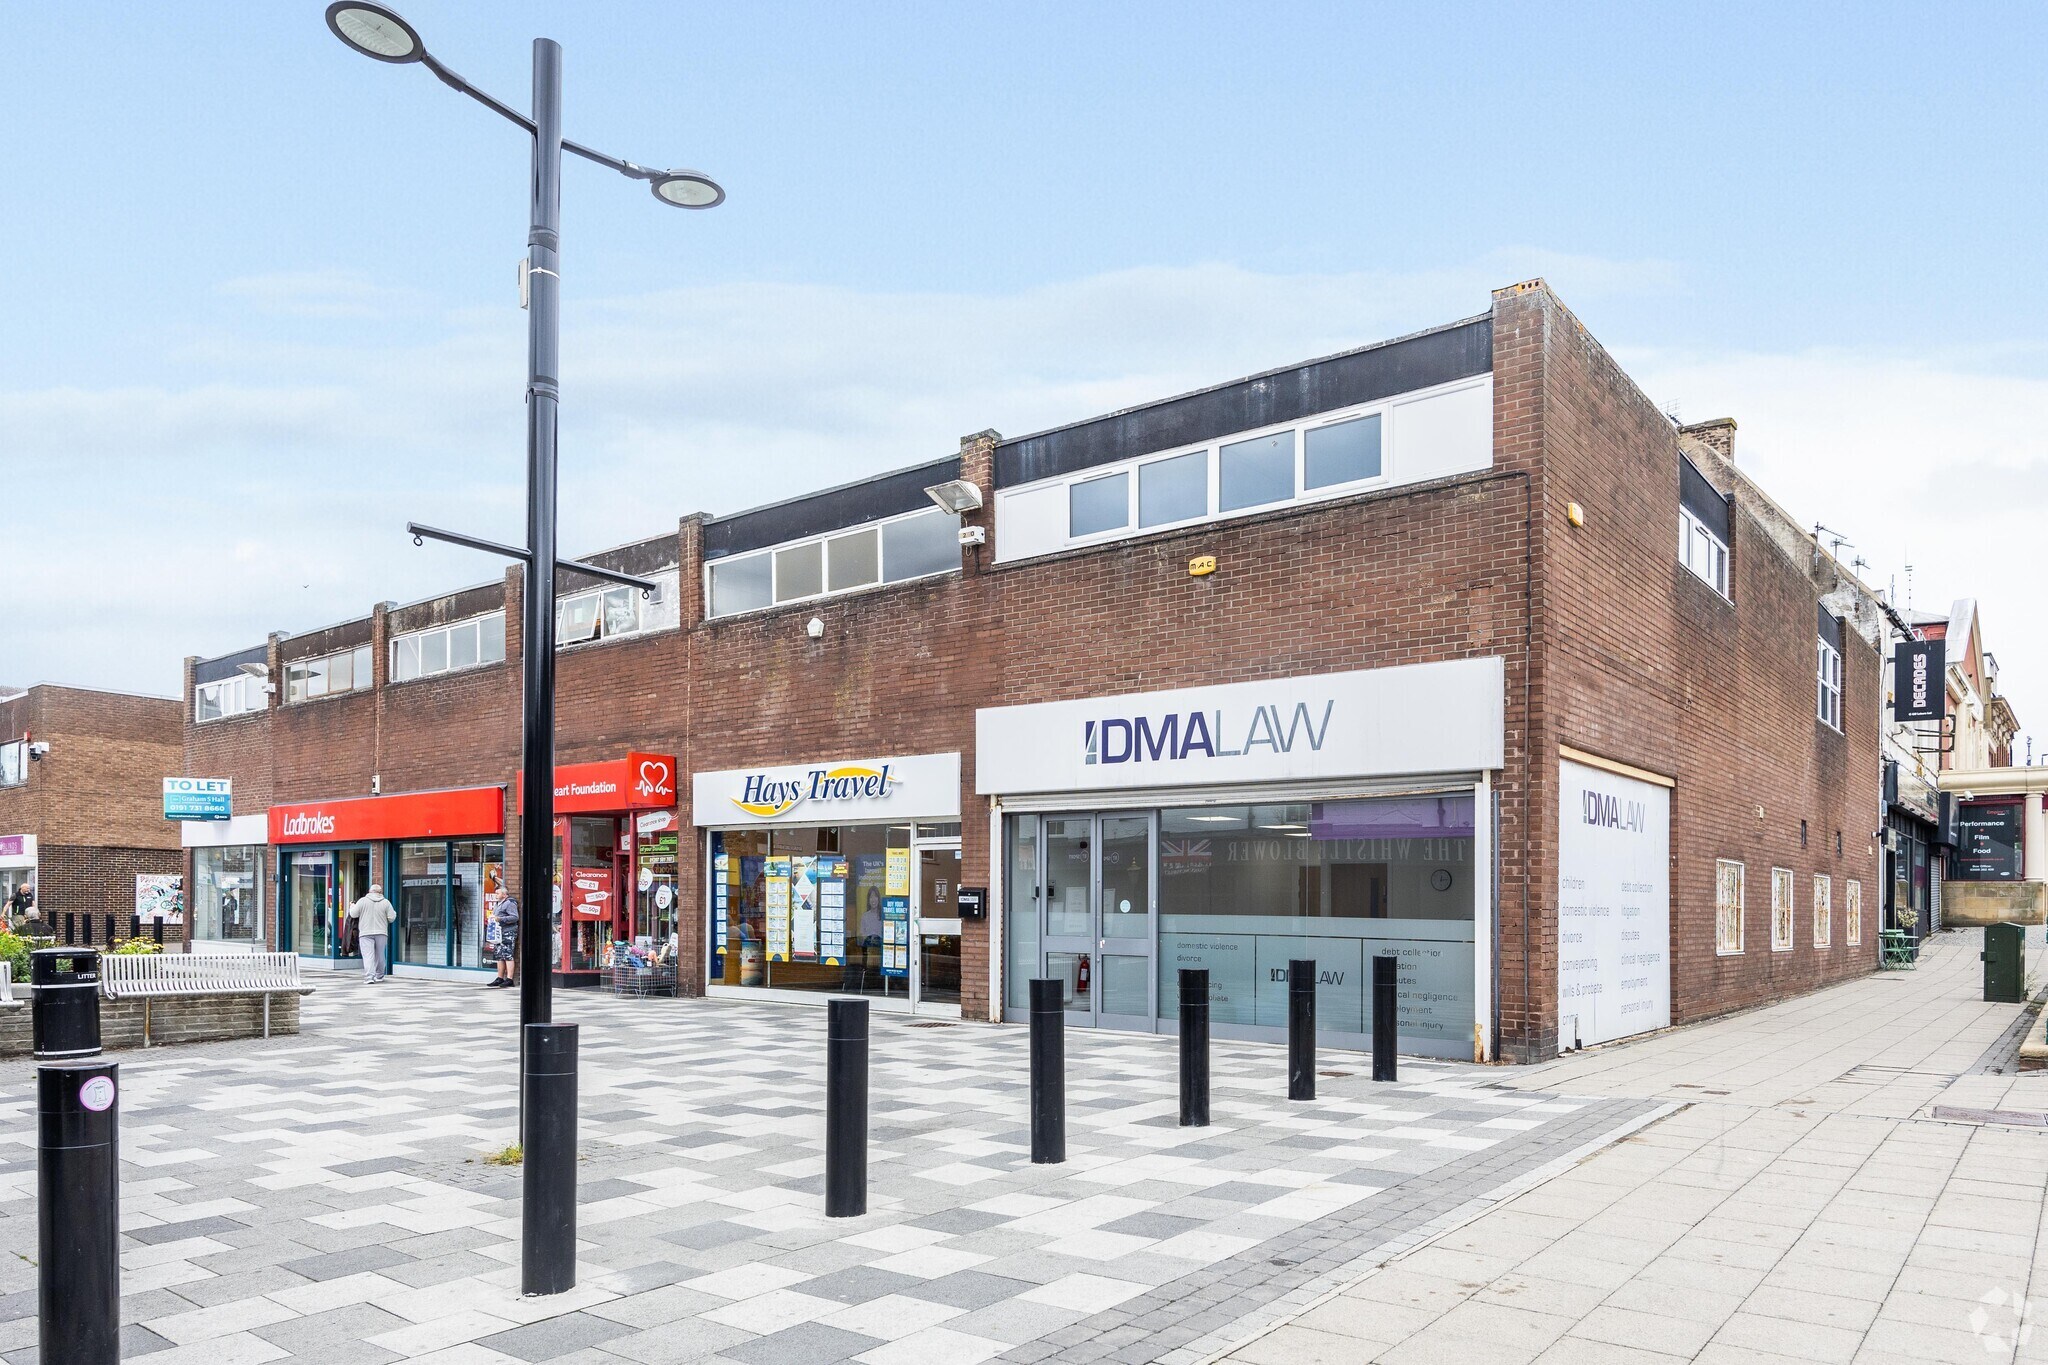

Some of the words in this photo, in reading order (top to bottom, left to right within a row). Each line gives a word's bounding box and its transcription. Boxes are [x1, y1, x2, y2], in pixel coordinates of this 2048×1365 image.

[1913, 653, 1927, 708] DECADES
[168, 780, 192, 790] TO
[196, 781, 227, 791] LET
[554, 785, 569, 796] eart
[571, 781, 616, 795] Foundation
[742, 774, 801, 809] Hays
[808, 765, 889, 799] Travel
[284, 811, 335, 836] Ladbrokes
[575, 870, 607, 878] Clearance
[1562, 876, 1585, 889] children
[659, 896, 666, 905] £1
[1562, 903, 1587, 917] domestic
[1589, 903, 1609, 917] violence
[1562, 930, 1582, 943] divorce
[1177, 942, 1208, 950] domestic
[1209, 942, 1239, 951] violence
[1381, 947, 1400, 956] debt
[1177, 954, 1202, 963] divorce
[1562, 955, 1597, 972] conveyancing
[77, 972, 97, 980] LITTER
[1576, 983, 1580, 996] &
[1582, 982, 1602, 996] probate
